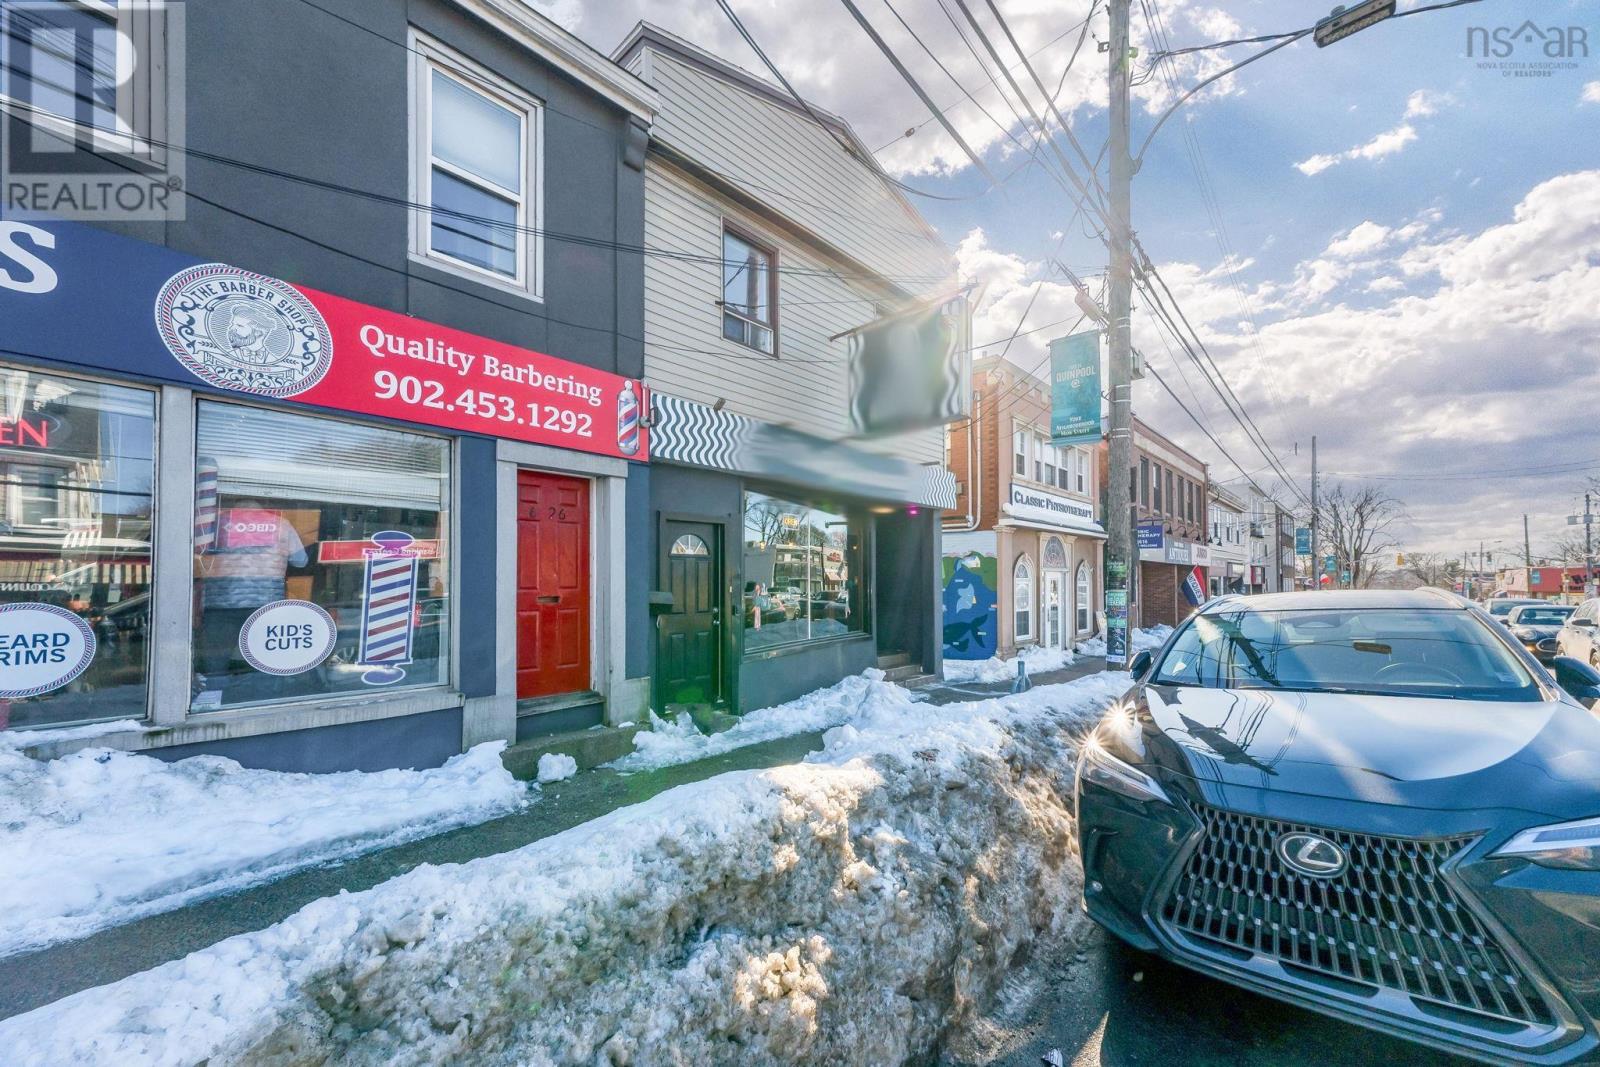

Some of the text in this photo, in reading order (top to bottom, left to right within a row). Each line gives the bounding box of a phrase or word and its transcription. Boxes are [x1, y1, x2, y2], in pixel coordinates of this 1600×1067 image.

[189, 281, 307, 329] THE BARBER SHOP
[359, 324, 602, 407] Quality Barbering
[373, 370, 593, 438] 902.453.1292
[264, 635, 313, 652] CUTS
[266, 624, 313, 638] KID'S
